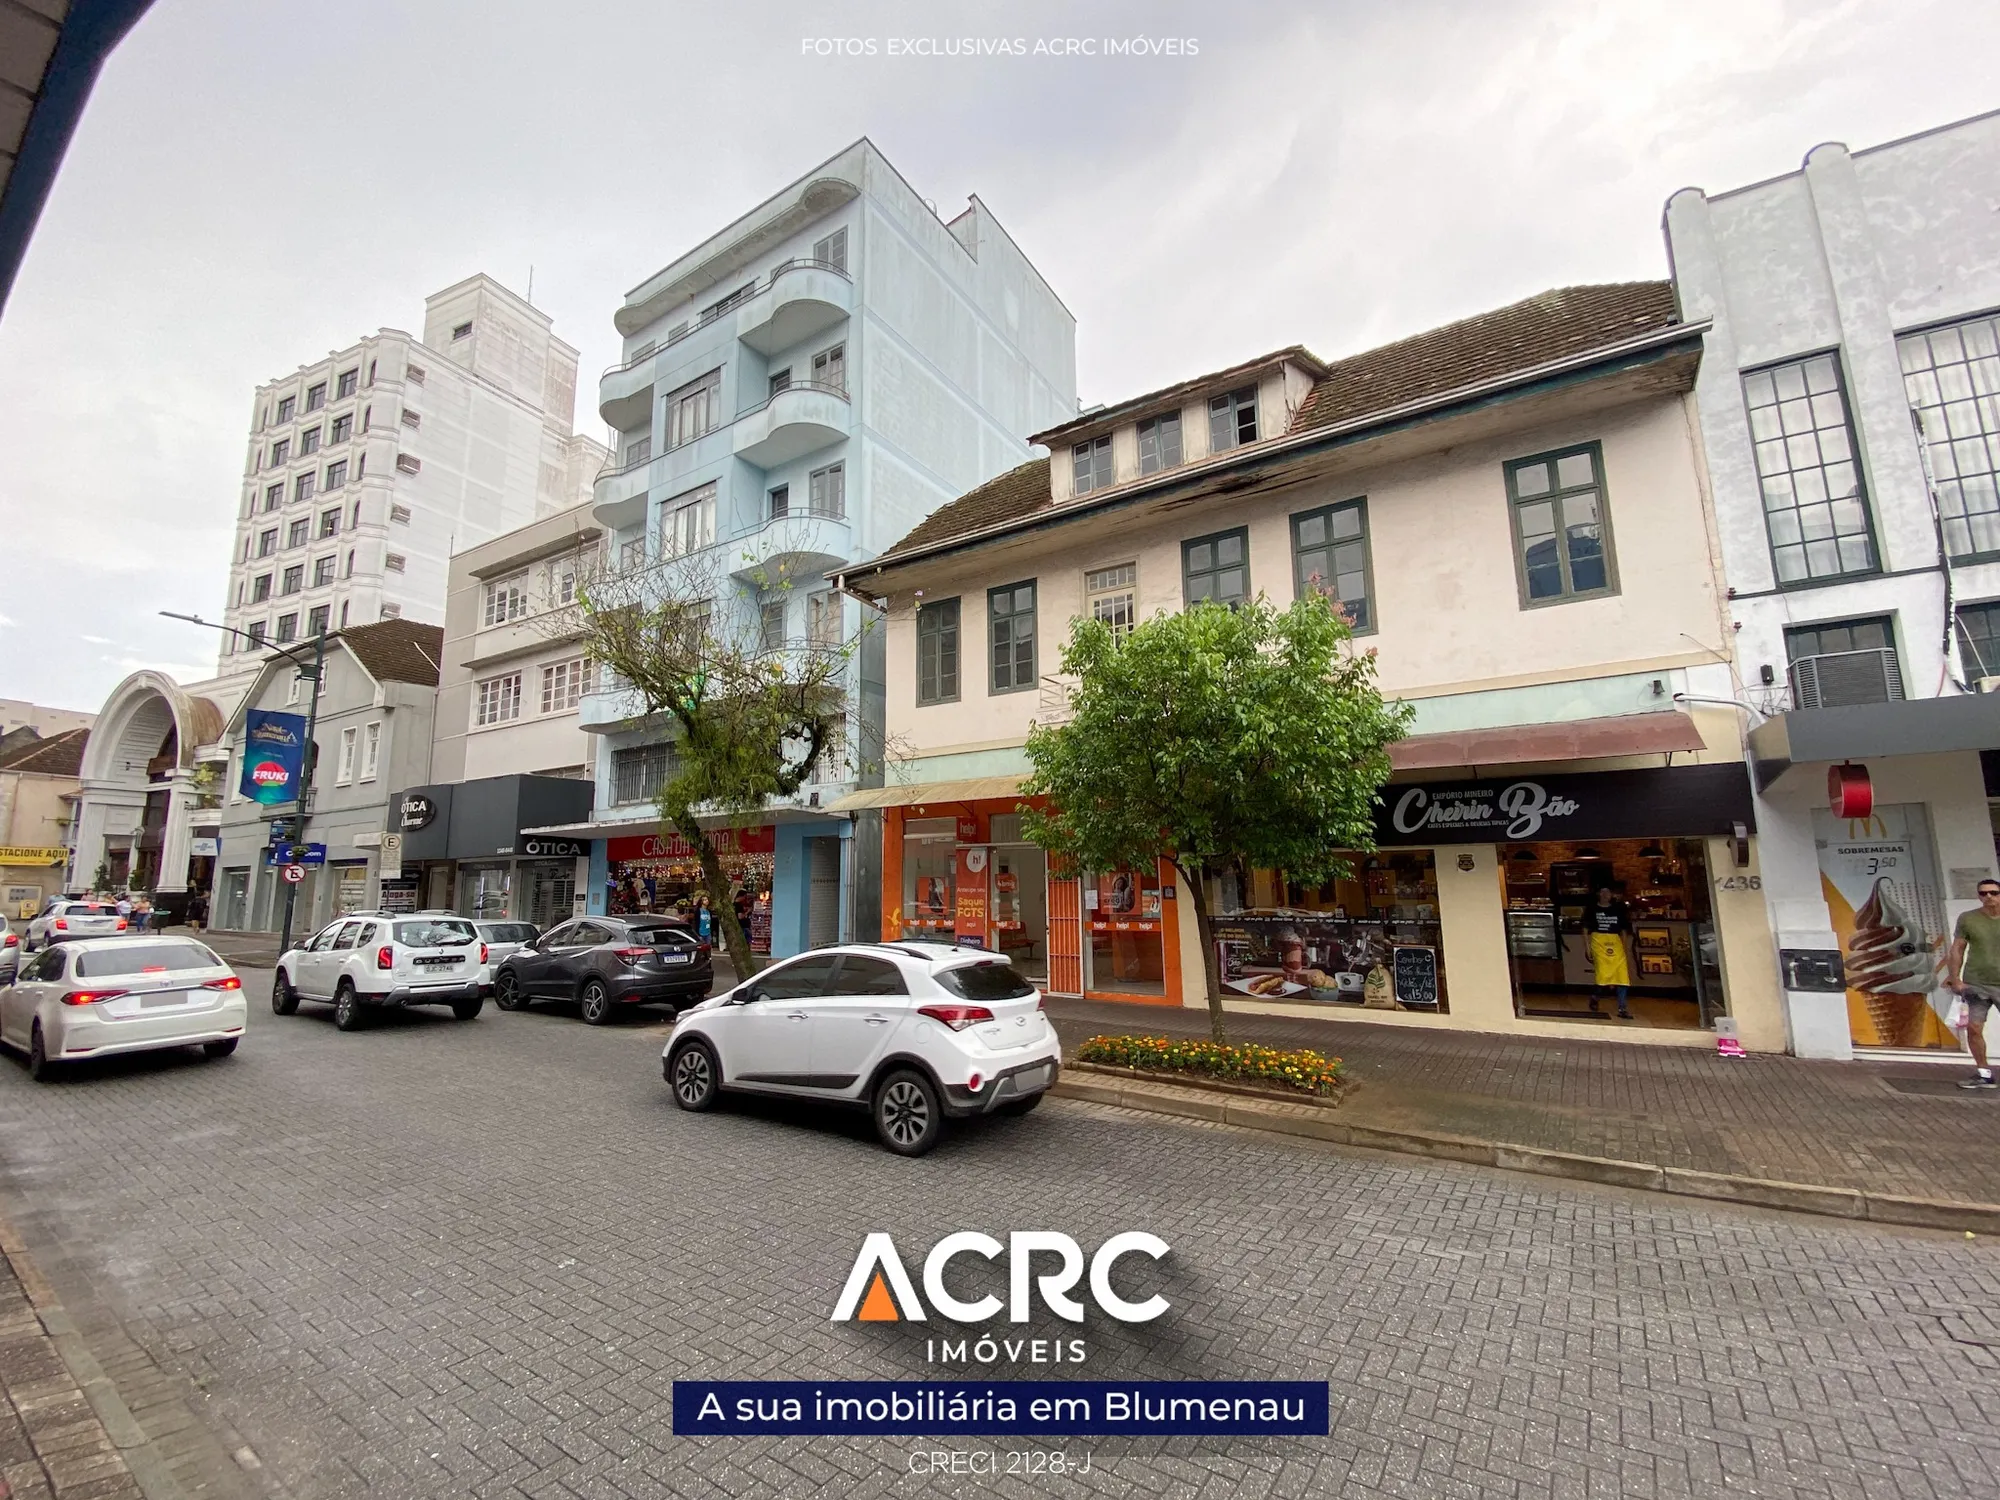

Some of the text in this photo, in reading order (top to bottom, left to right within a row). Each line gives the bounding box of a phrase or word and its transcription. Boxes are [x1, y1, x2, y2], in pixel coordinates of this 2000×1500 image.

[252, 770, 289, 781] FRUKI
[1432, 789, 1462, 800] EMPÓRIO
[401, 797, 427, 814] ÓTICA
[1393, 782, 1580, 839] Cheirin Bão
[960, 824, 976, 836] help!
[388, 837, 395, 847] E
[526, 839, 581, 854] ÓTICA
[642, 836, 672, 856] CASA
[676, 834, 690, 854] DA
[0, 848, 68, 859] STACIONE AQUI
[1837, 846, 1904, 855] SOBREMESAS
[973, 855, 981, 864] h!
[958, 897, 984, 907] Saque
[957, 907, 984, 917] FGTS
[1094, 922, 1107, 930] help!
[1115, 922, 1129, 930] help!
[1139, 922, 1153, 930] help!
